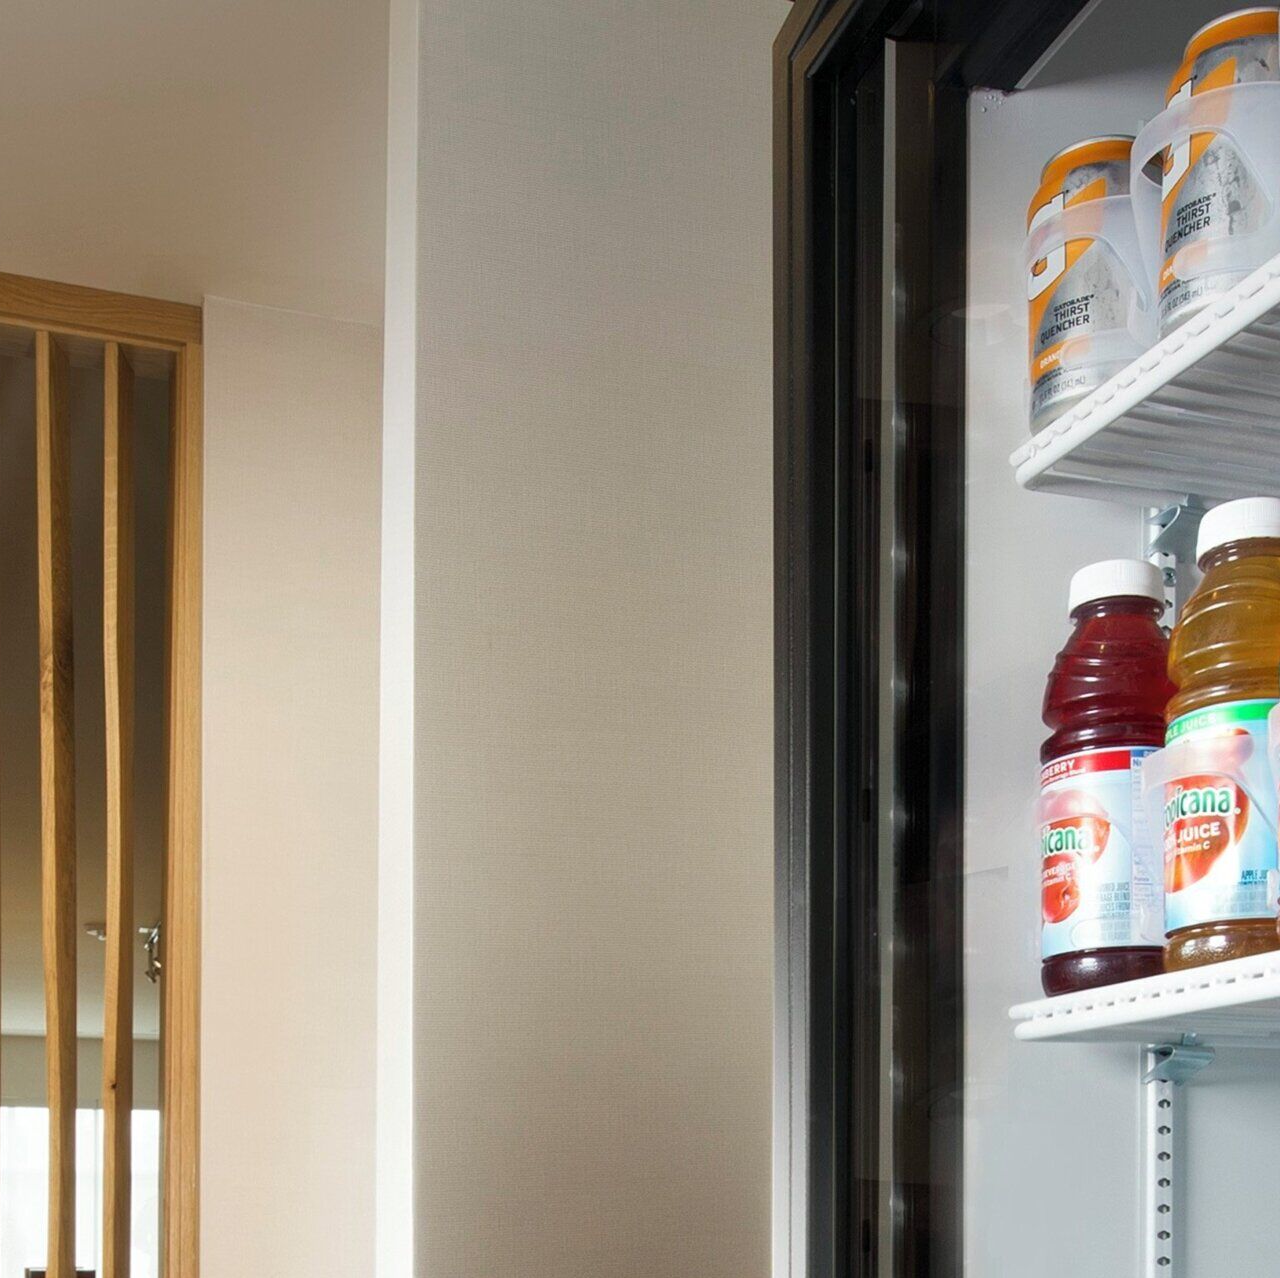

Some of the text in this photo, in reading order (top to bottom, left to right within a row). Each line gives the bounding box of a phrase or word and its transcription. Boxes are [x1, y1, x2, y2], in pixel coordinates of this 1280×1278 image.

[1176, 202, 1211, 228] THIRST
[1165, 216, 1211, 253] QUENCHER
[1054, 303, 1090, 323] THIRST
[1040, 314, 1090, 344] QUENCHER
[1177, 821, 1221, 843] JUICE
